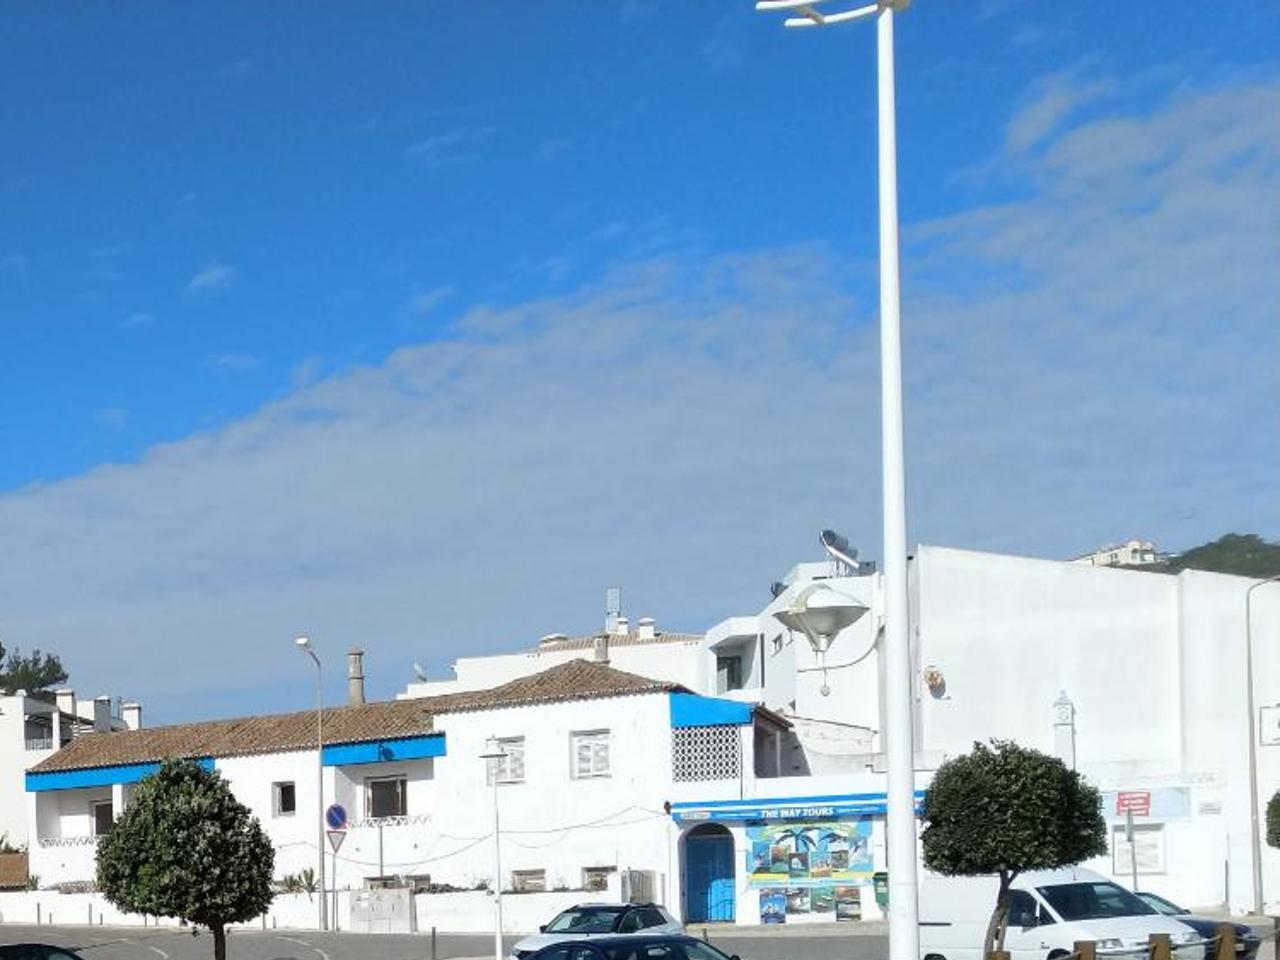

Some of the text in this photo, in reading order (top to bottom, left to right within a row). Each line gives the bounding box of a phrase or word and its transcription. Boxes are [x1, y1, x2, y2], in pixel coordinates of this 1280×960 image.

[761, 806, 835, 818] THE WAY TOURS
